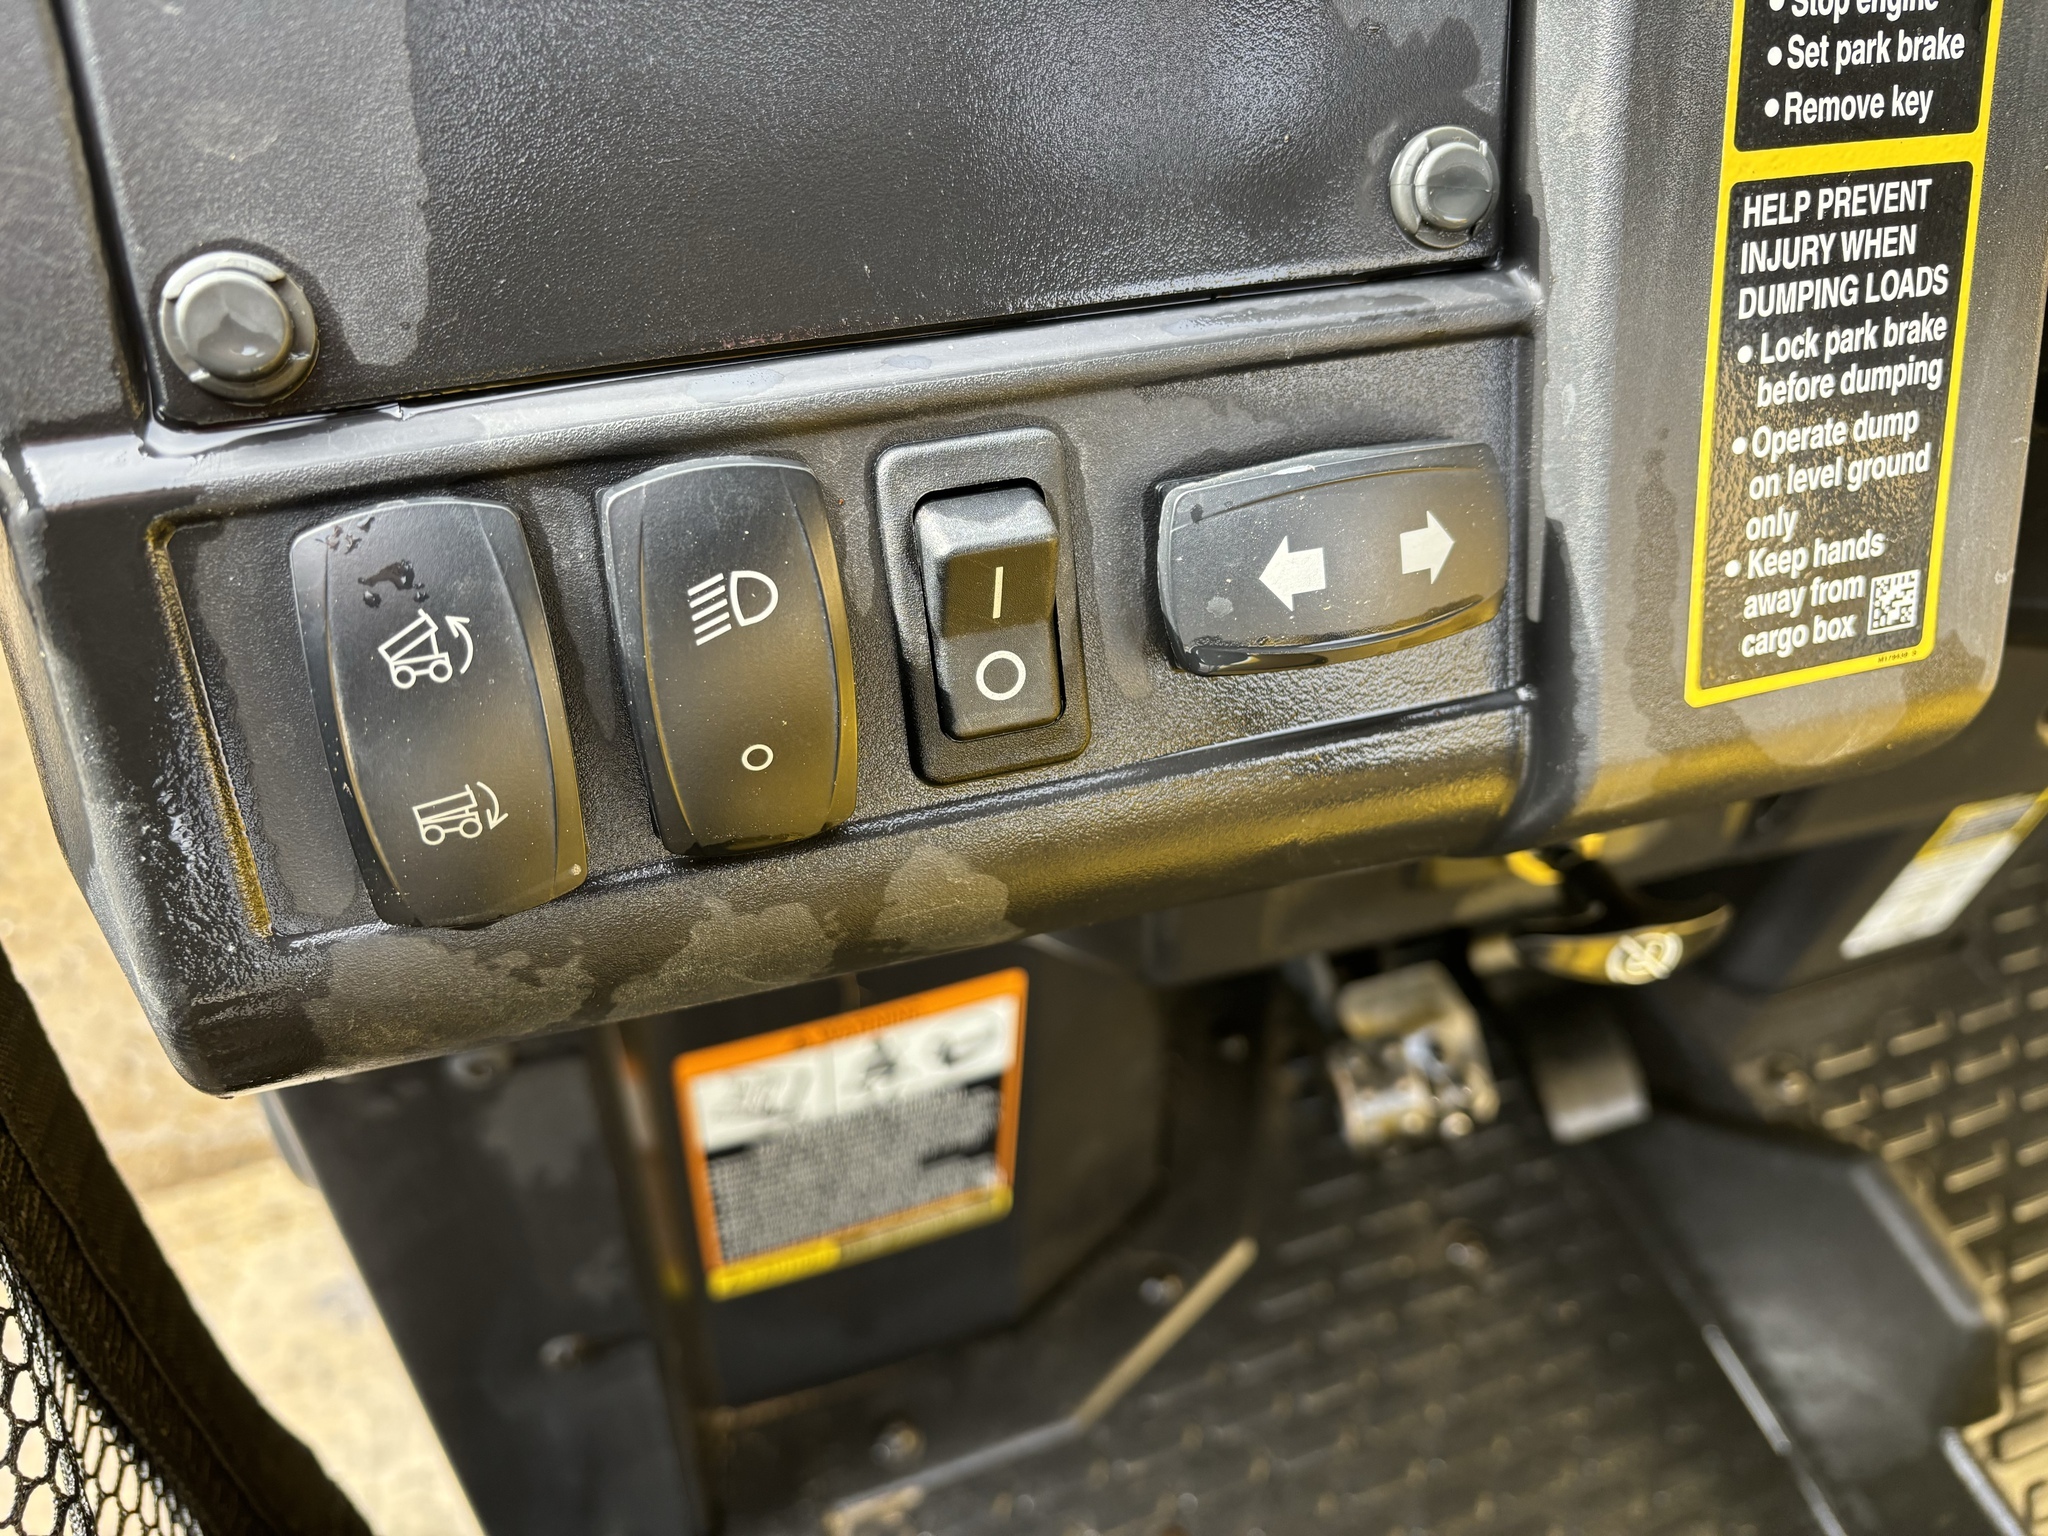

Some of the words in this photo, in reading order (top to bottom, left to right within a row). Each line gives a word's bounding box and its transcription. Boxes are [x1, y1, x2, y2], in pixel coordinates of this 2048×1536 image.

[1787, 34, 1829, 70] Set
[1835, 30, 1892, 75] park
[1897, 26, 1965, 63] brake
[1784, 91, 1885, 125] Remove
[1892, 84, 1934, 124] key
[1743, 191, 1811, 229] HELP
[1817, 178, 1932, 221] PREVENT
[1740, 232, 1838, 275] INJURY
[1840, 224, 1917, 263] WHEN
[1738, 277, 1858, 320] DUMPING
[1865, 264, 1949, 304] LOADS
[1760, 326, 1820, 364] Lock
[1824, 319, 1880, 363] park
[1884, 312, 1947, 350] brake
[1756, 370, 1835, 408] before
[1840, 357, 1944, 397] dumping
[1752, 418, 1848, 464] Operate
[1853, 410, 1920, 444] dump
[1749, 473, 1779, 500] on
[1786, 457, 1841, 495] level
[1846, 441, 1932, 492] ground
[1745, 504, 1798, 543] only
[1747, 548, 1808, 580] Keep
[1812, 529, 1885, 567] hands
[1743, 586, 1807, 620] away
[1809, 573, 1866, 606] from
[1740, 625, 1809, 659] cargo
[1812, 612, 1856, 645] box
